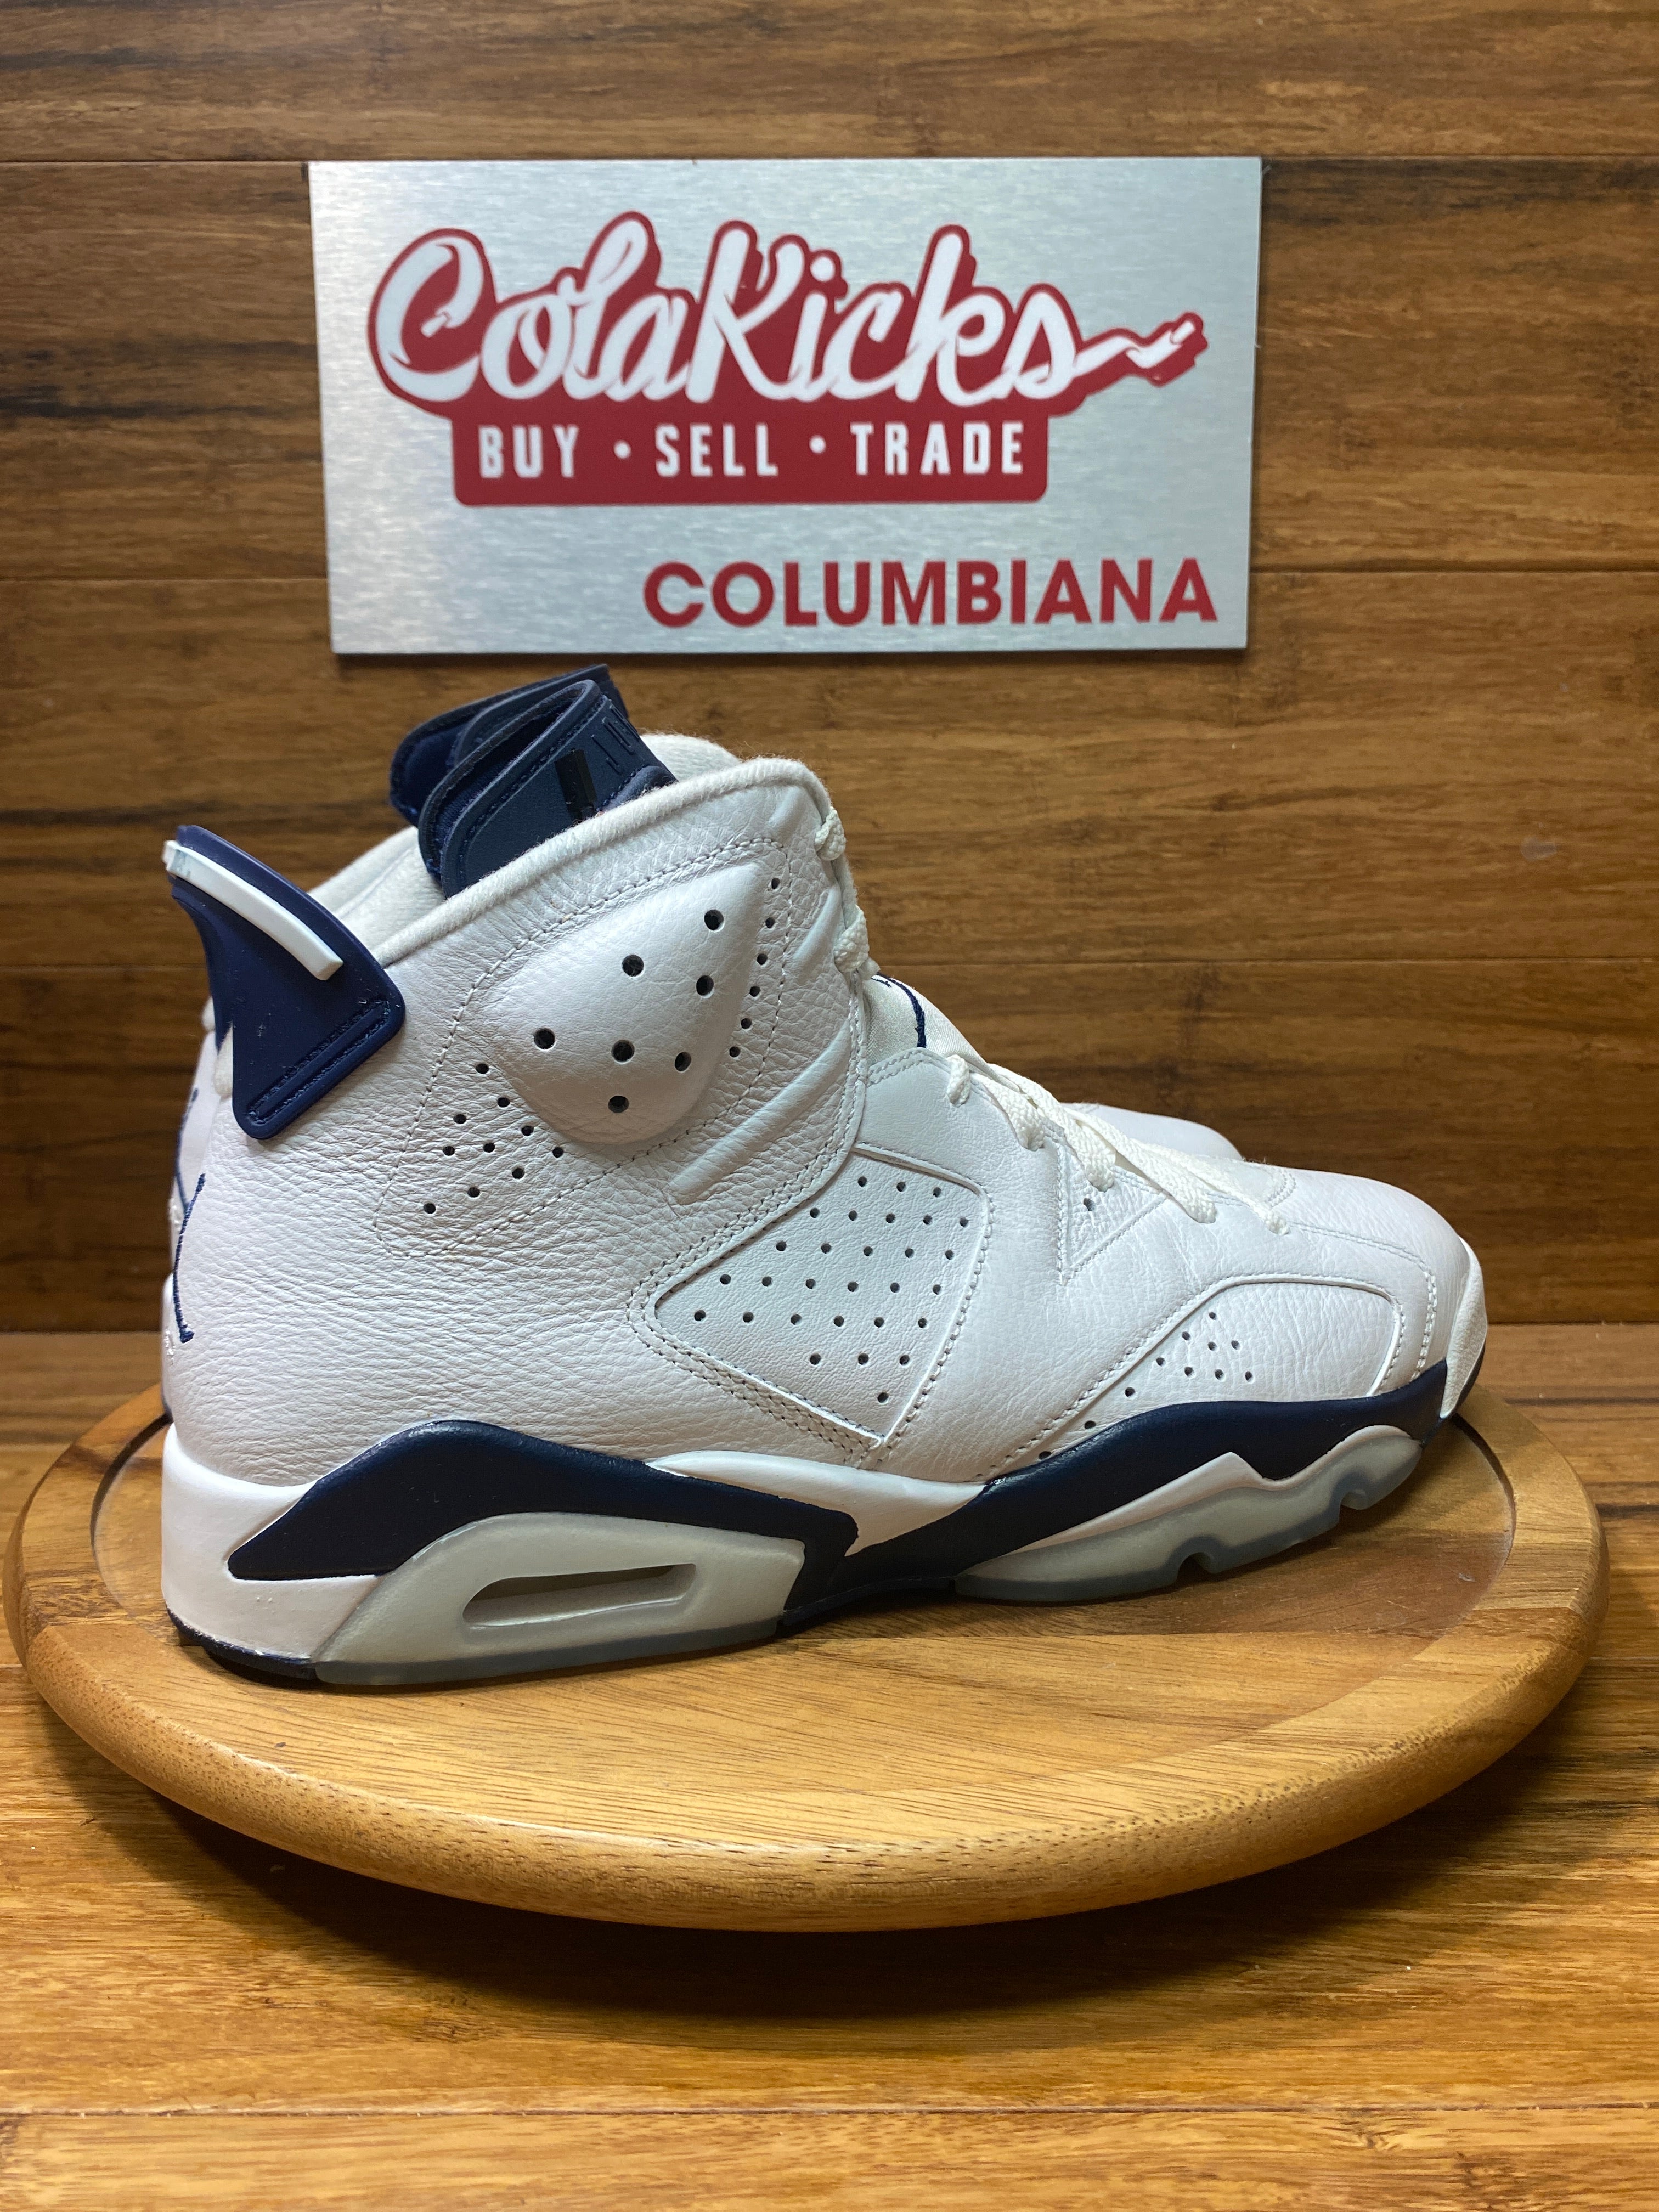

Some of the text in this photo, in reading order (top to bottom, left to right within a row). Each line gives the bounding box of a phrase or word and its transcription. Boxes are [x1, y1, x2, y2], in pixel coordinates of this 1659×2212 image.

[478, 421, 1024, 479] BUY SELL TRADE
[645, 560, 1216, 626] COLUMBIANA
